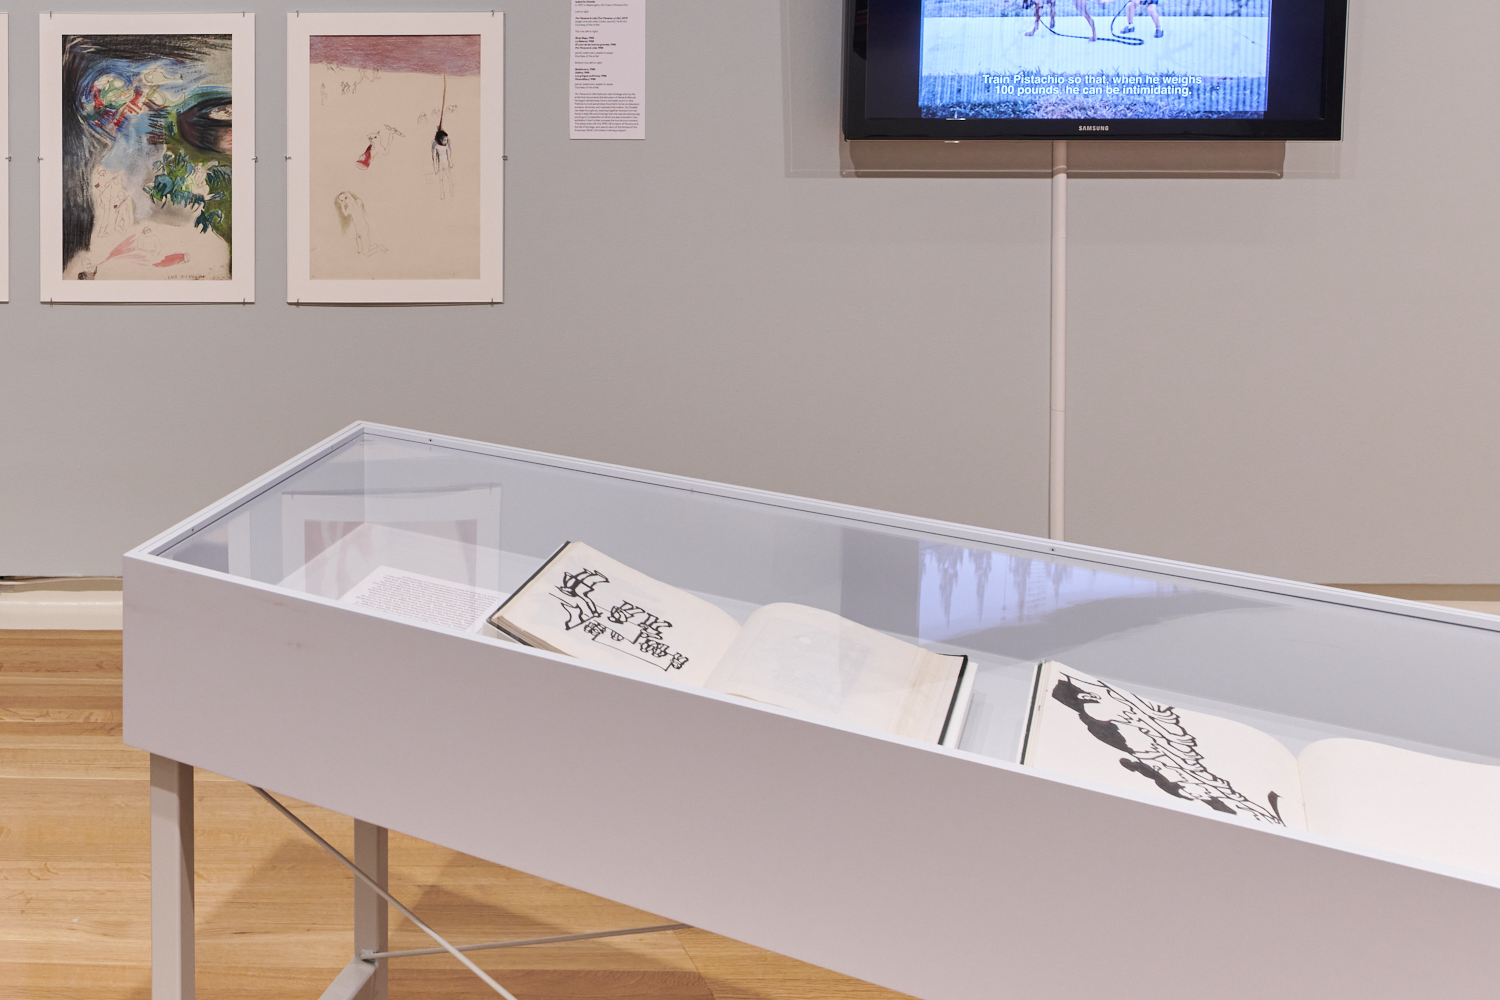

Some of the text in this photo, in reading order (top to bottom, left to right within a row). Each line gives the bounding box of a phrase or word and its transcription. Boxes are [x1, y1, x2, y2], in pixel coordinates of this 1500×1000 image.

[982, 75, 1009, 84] Train
[1013, 75, 1064, 84] Pistachio
[1113, 75, 1142, 84] when
[1146, 75, 1159, 84] he
[1163, 75, 1202, 86] weighs
[995, 86, 1014, 94] 100
[1065, 85, 1079, 94] he
[1106, 85, 1119, 94] be
[1123, 85, 1192, 96] intimidating.
